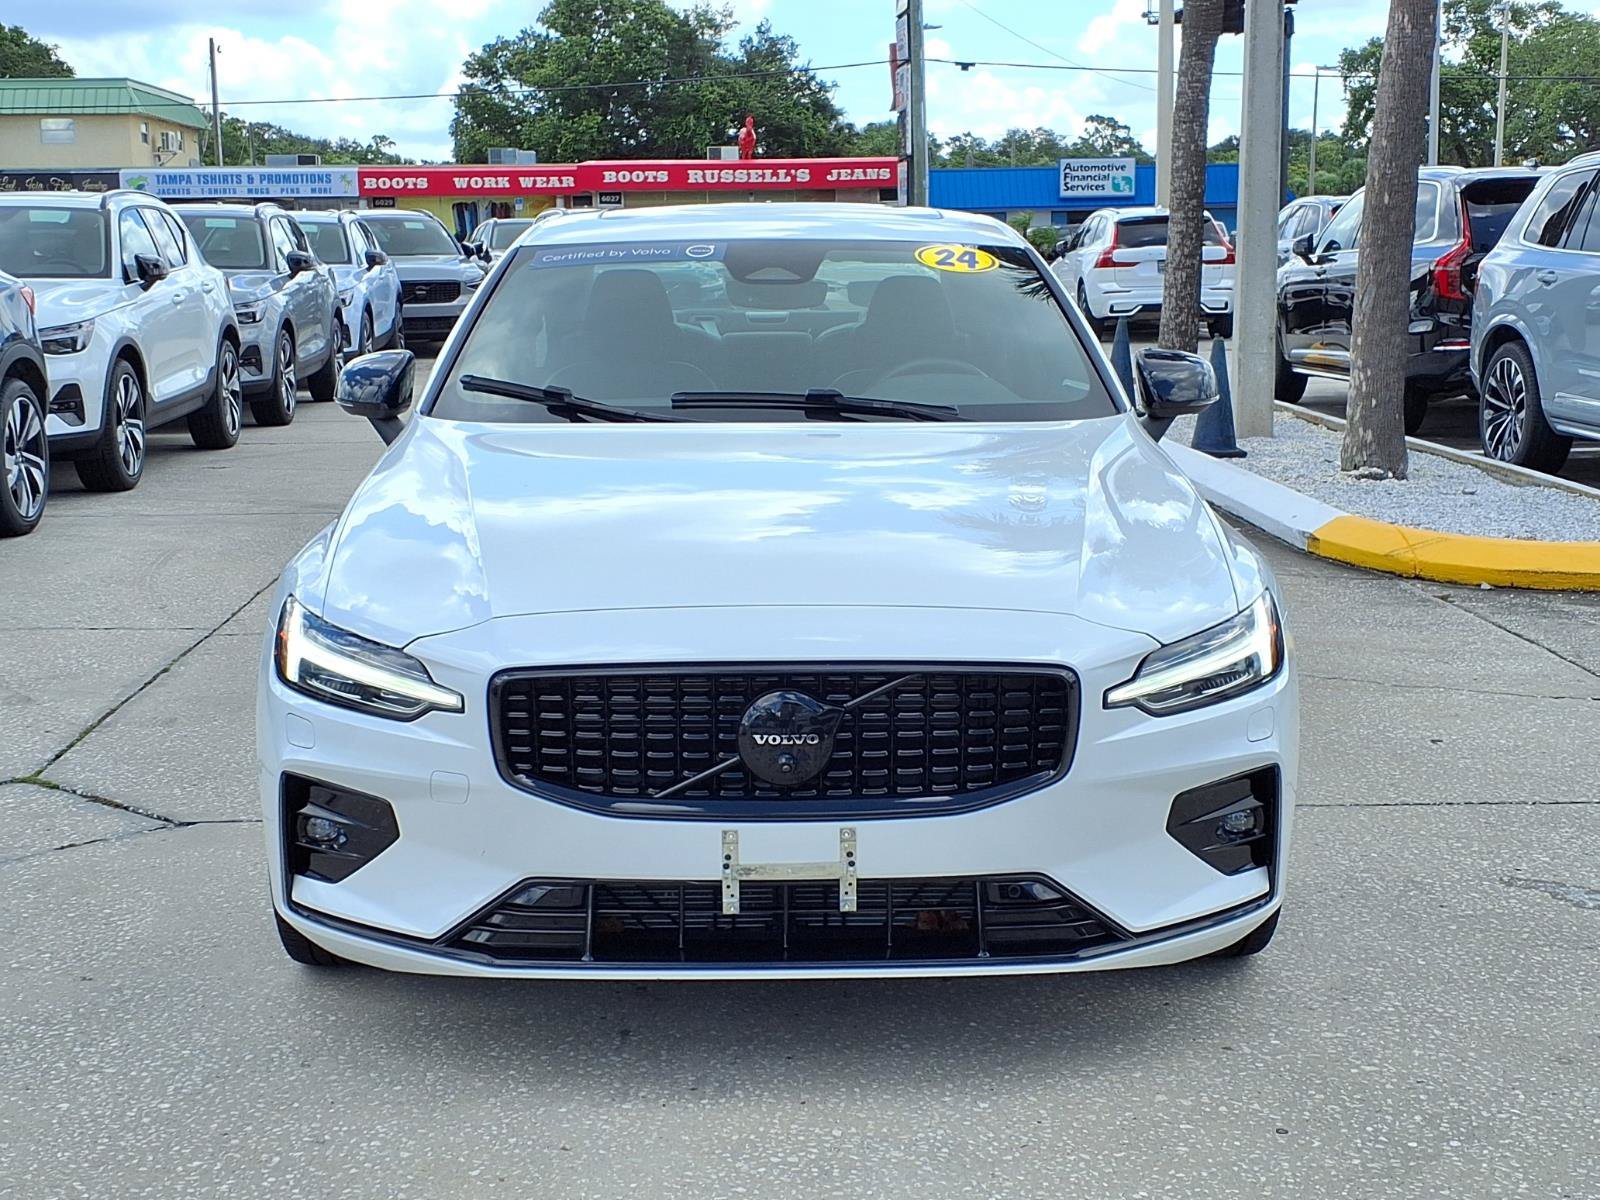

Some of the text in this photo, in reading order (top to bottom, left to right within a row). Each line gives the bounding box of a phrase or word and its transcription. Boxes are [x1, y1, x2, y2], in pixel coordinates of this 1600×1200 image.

[1063, 163, 1126, 172] Automotive
[155, 173, 332, 185] TAMPA TSHIRTS & PROMOTIONS
[602, 170, 668, 183] BOOTS
[687, 168, 810, 184] RUSSELL'S
[826, 168, 891, 181] JEANS
[1063, 172, 1110, 182] Financial
[363, 177, 428, 189] BOOTS
[452, 176, 575, 189] WORK WEAR
[1063, 182, 1105, 191] Services
[542, 247, 671, 262] Certified by Volvo
[934, 248, 979, 269] 24
[752, 734, 819, 745] VOLVO
